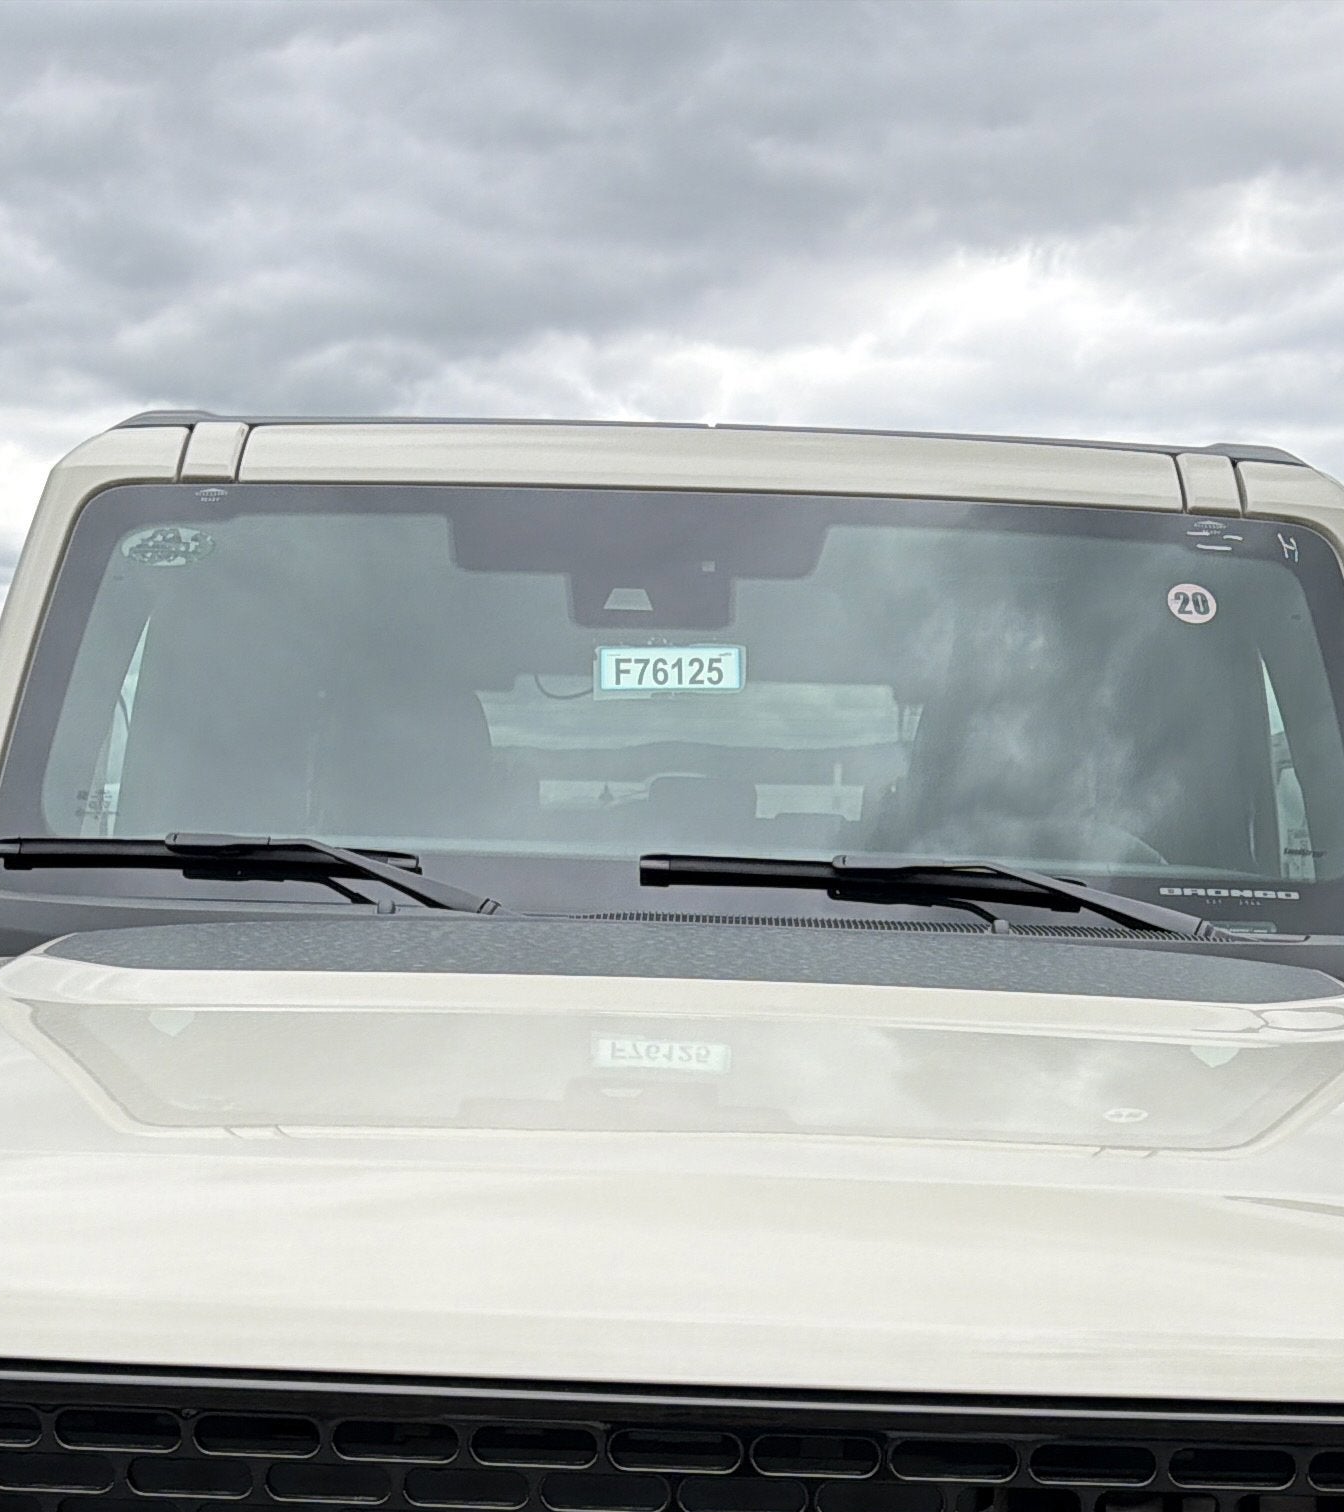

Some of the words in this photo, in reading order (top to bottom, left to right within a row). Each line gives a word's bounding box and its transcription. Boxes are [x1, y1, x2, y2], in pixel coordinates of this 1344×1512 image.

[1174, 591, 1210, 615] 20
[614, 657, 724, 685] F76125
[1159, 887, 1299, 900] BRONCO
